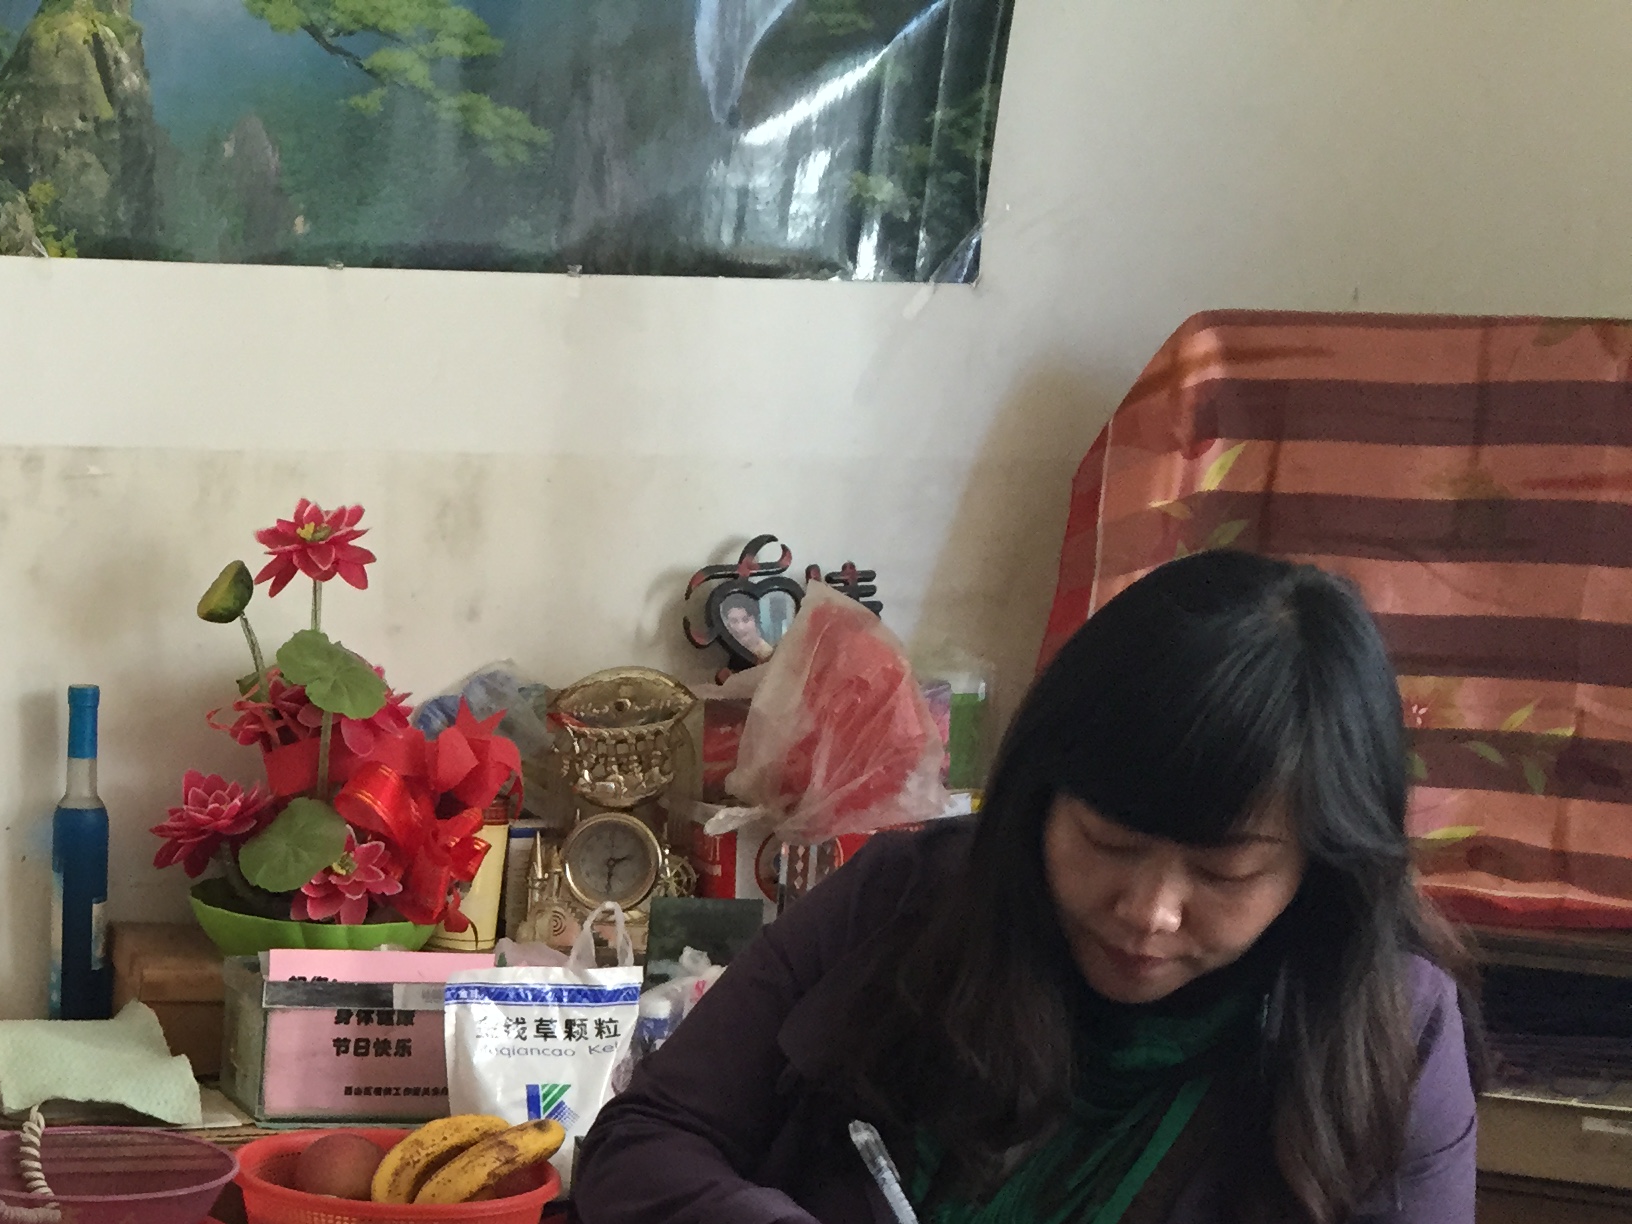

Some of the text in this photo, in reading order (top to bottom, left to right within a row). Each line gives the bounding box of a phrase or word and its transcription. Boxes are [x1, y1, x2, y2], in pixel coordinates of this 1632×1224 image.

[332, 1037, 413, 1057] 节日快乐
[480, 1042, 576, 1058] qiancao
